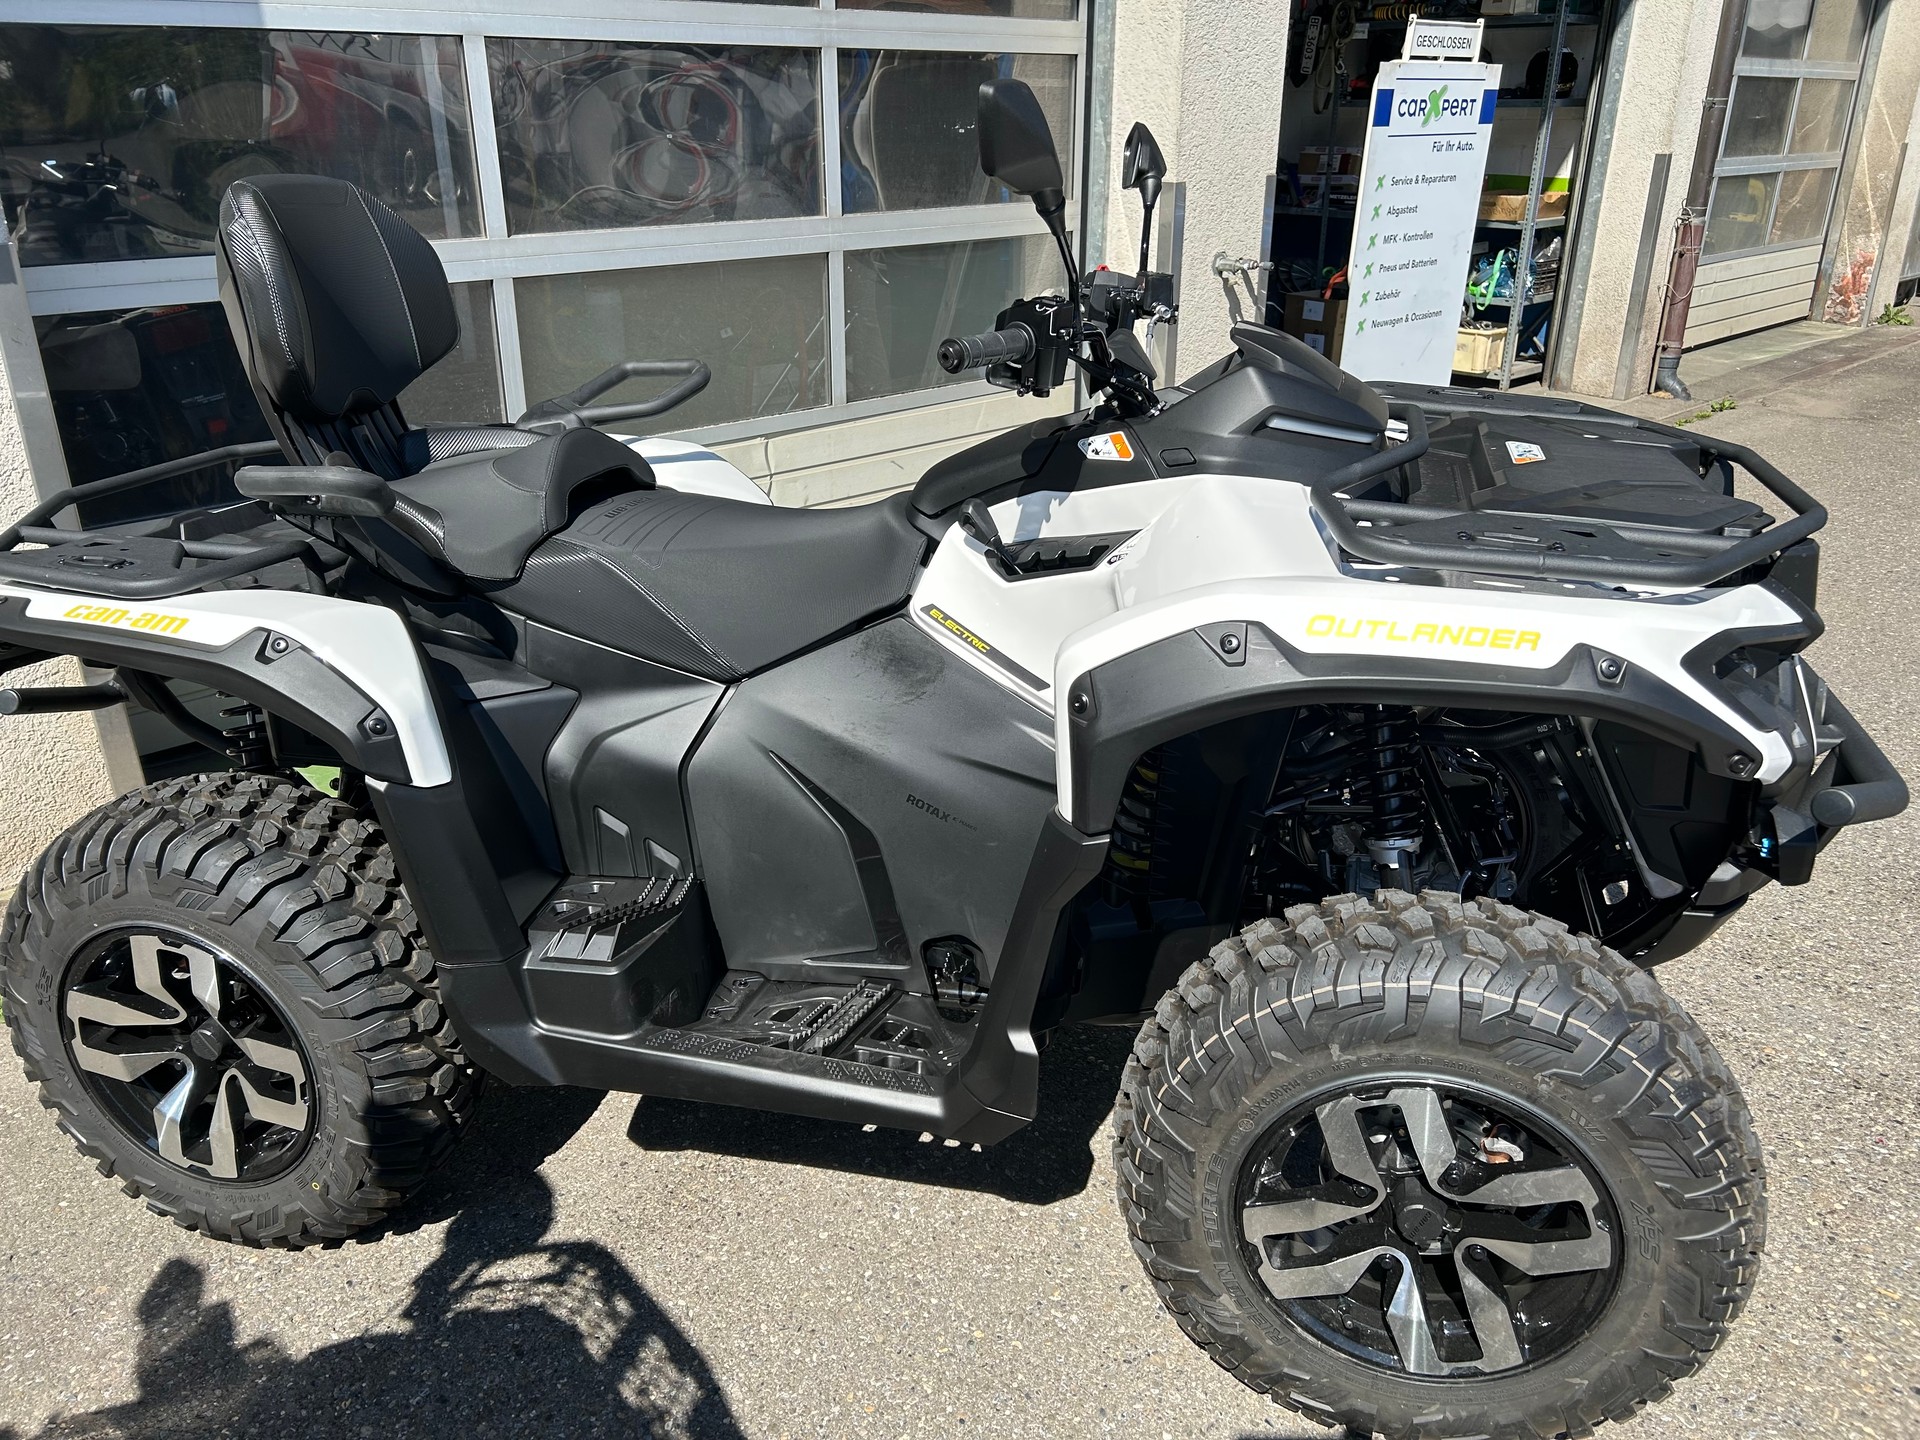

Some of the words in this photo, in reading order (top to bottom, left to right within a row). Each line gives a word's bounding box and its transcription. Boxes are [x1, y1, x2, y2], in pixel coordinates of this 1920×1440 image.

[1416, 35, 1473, 50] GESCHLOSSEN
[1432, 141, 1444, 152] Für
[1445, 141, 1455, 152] Ihr
[1456, 140, 1475, 151] Auto.
[1390, 176, 1413, 187] Service
[1414, 174, 1421, 182] &
[1421, 173, 1457, 186] Reparaturen
[1386, 204, 1418, 218] Abgastest
[1382, 233, 1398, 245] MFK
[1402, 230, 1434, 242] Kontrollen
[1378, 262, 1397, 273] Pneus
[1398, 260, 1410, 270] und
[1411, 257, 1438, 269] Batterien
[1374, 289, 1401, 302] Zubehör
[152, 304, 189, 318] HONDA
[1371, 316, 1404, 329] Neuwagen
[1410, 309, 1443, 322] Occasionen
[63, 604, 190, 635] can-am
[929, 608, 991, 653] ELECTRIC
[1305, 614, 1542, 652] OUTLANDER
[905, 793, 951, 823] ROTAX
[1443, 1059, 1482, 1076] RADIAL
[1202, 1153, 1227, 1249] FORCE
